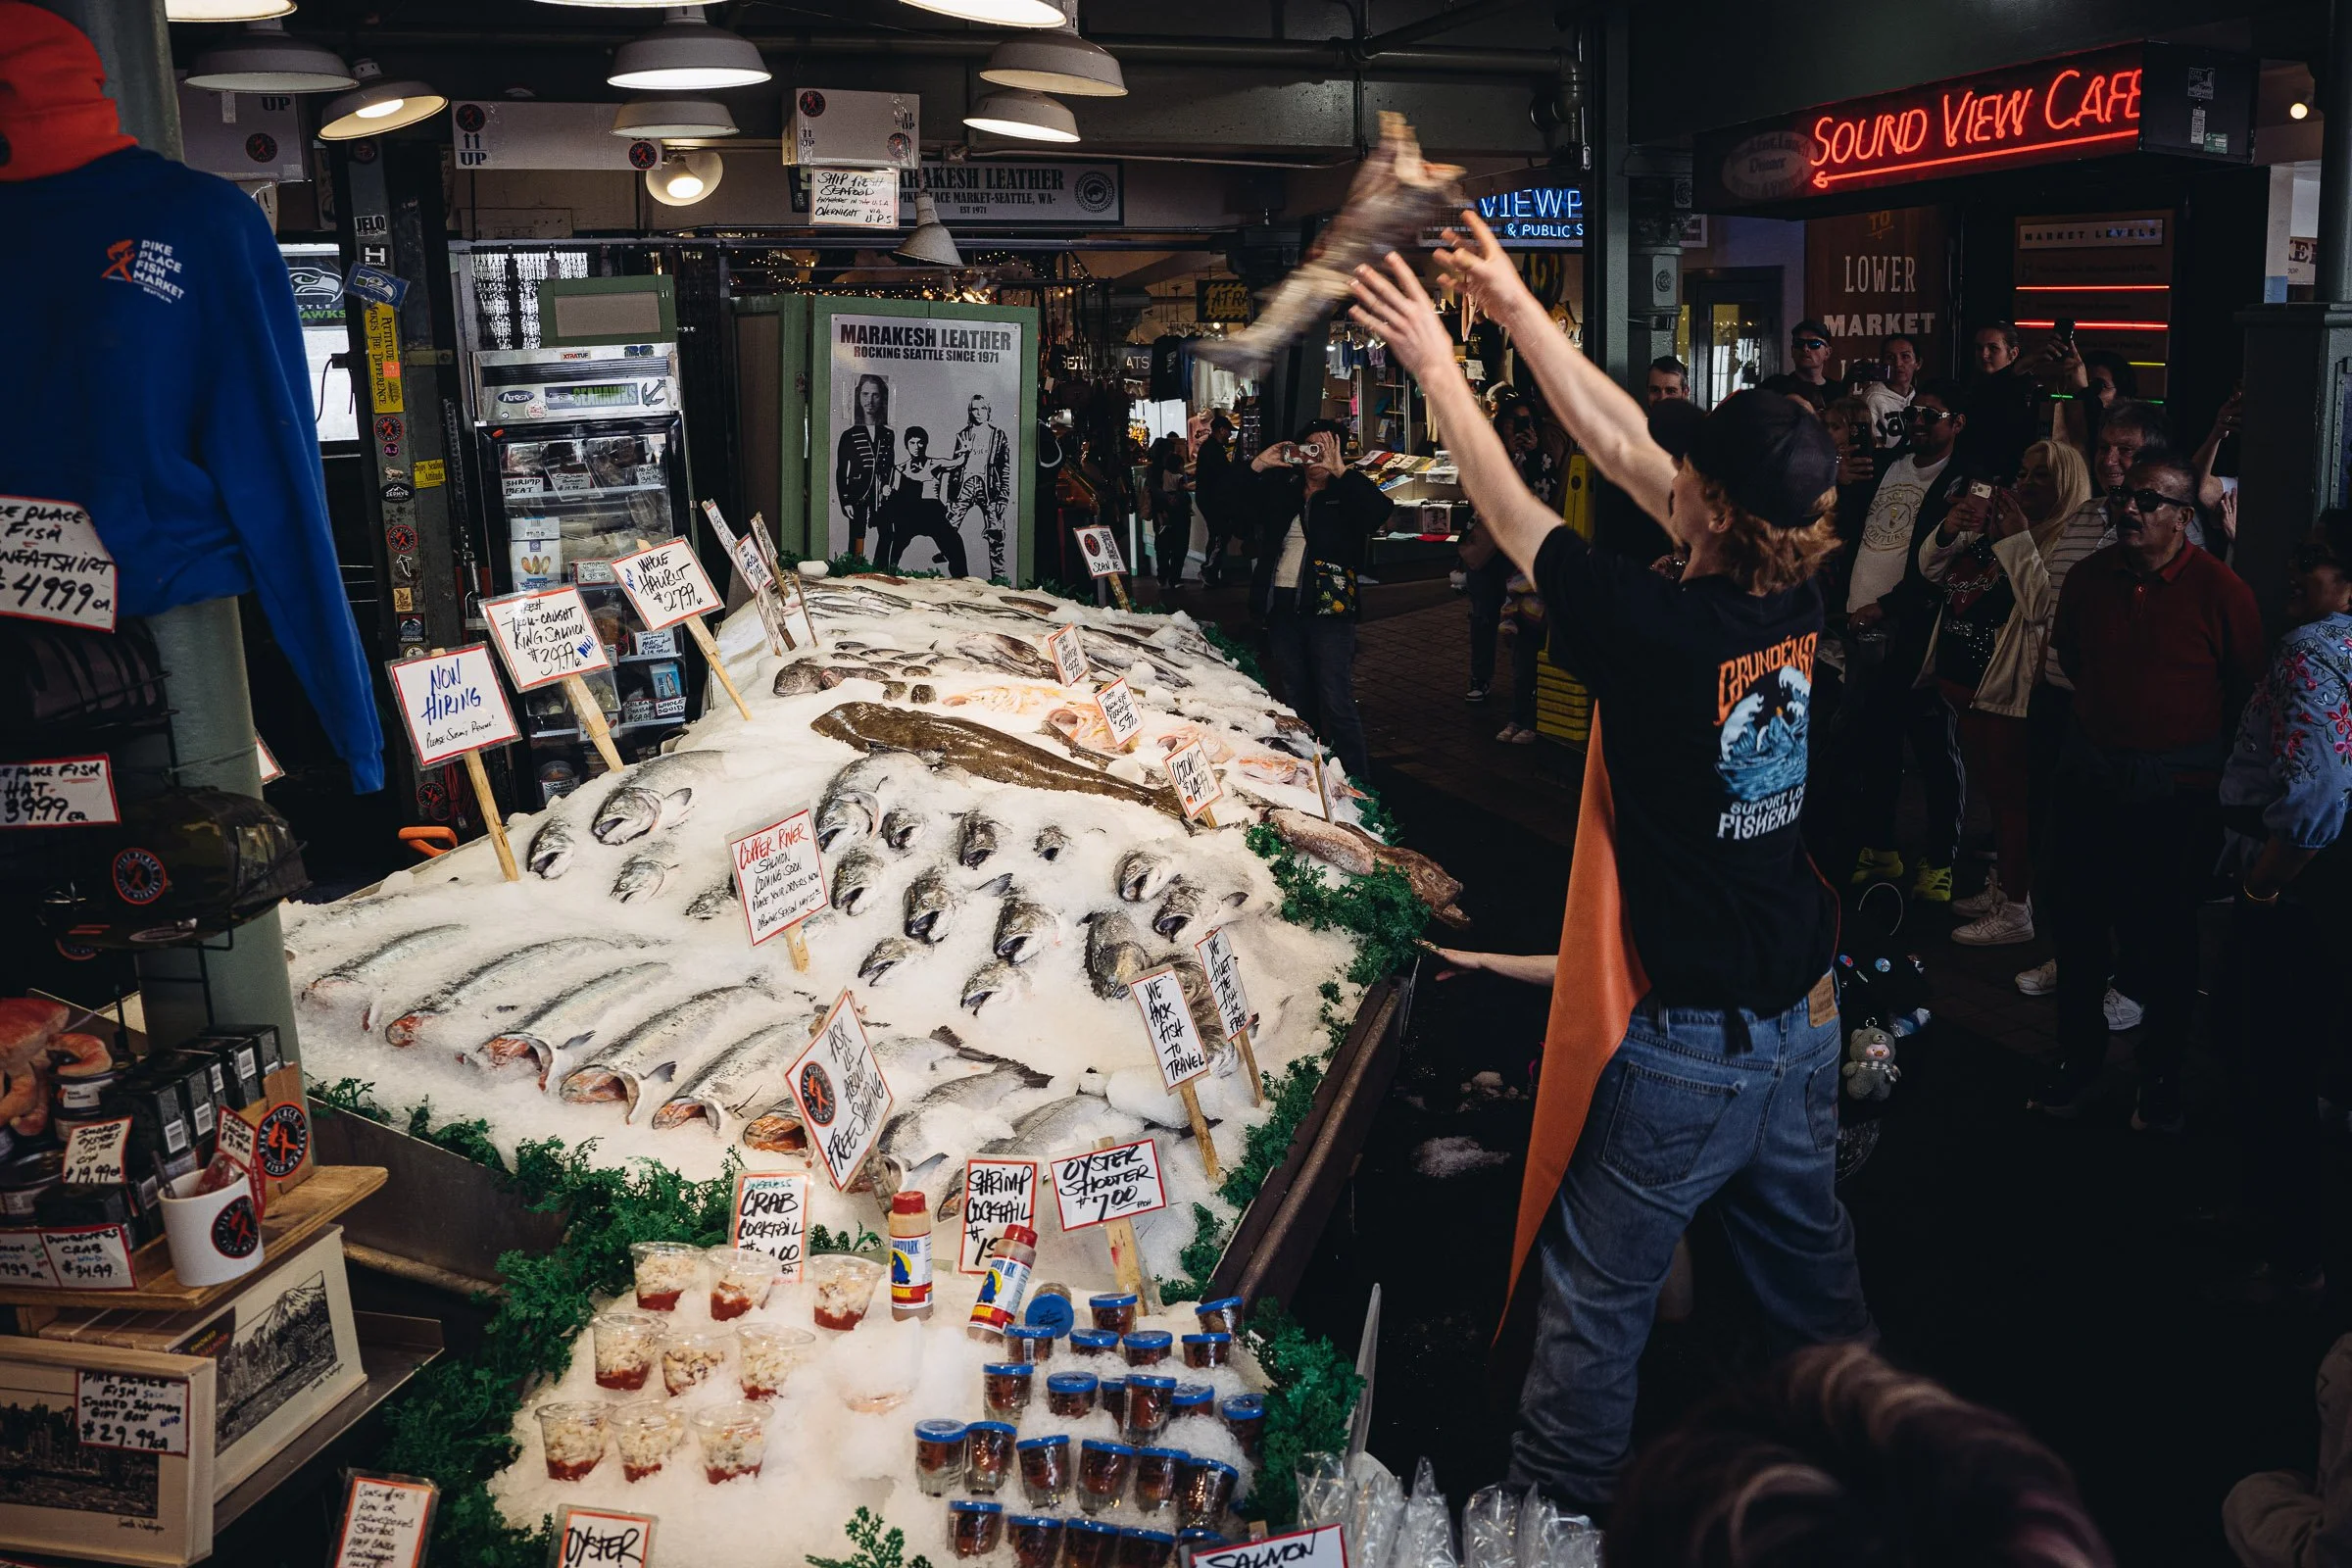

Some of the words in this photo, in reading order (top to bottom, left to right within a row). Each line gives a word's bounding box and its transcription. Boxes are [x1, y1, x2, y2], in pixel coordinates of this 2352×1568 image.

[262, 96, 291, 111] UP
[1811, 108, 1928, 167] SOUND
[1944, 88, 2034, 147] VIEW
[461, 152, 487, 166] UP
[817, 172, 849, 186] SHIP
[899, 168, 979, 190] ARAKESH
[984, 169, 1064, 191] LEATHER
[820, 187, 875, 197] SEAFOOD
[814, 205, 859, 219] OVERNIGHT
[959, 206, 971, 215] EST
[972, 206, 988, 215] 1971
[1507, 223, 1517, 237] &
[1522, 223, 1570, 237] PUBLIC
[2025, 231, 2084, 241] MARKET
[2095, 228, 2156, 238] LEVELS
[141, 239, 173, 257] PIKE
[135, 260, 166, 278] FISH
[138, 250, 183, 273] PLACE
[132, 270, 185, 300] MARKET
[1844, 256, 1916, 293] LOWER
[840, 323, 937, 348] MARAKESH
[941, 328, 1011, 351] LEATHER
[1824, 313, 1936, 337] MARKET
[370, 334, 382, 350] THE
[854, 346, 901, 360] ROCKING
[903, 348, 944, 362] SEATTLE
[946, 349, 976, 363] SINCE
[977, 352, 1000, 364] 1971
[372, 353, 387, 406] DIFFERENCE
[572, 386, 636, 407] SEAHAWKS
[506, 478, 541, 487] SHRIMP
[24, 506, 83, 523] PLACE
[5, 521, 62, 543] FISH
[637, 551, 671, 574] WHOLE
[1093, 561, 1110, 573] SCAN
[638, 563, 691, 596] HALIBUT
[514, 627, 543, 651] KING
[544, 613, 586, 643] SALMON
[431, 658, 462, 696] NOW
[420, 687, 482, 725] HIRING
[658, 699, 683, 709] WHOLE
[658, 705, 683, 713] SQUID
[426, 731, 446, 750] PLEASE
[17, 766, 53, 776] PLACE
[58, 762, 101, 776] FISH
[1731, 795, 1786, 816] SUPPORT
[740, 836, 776, 870] COPPER
[778, 823, 809, 850] RIVER
[755, 848, 791, 874] SALMON
[756, 868, 782, 896] COMING
[753, 895, 769, 913] PLACE
[1208, 934, 1220, 958] WE
[1145, 978, 1164, 1003] WE
[1215, 976, 1232, 995] THE
[1218, 989, 1239, 1012] FISH
[1149, 1001, 1177, 1028] PACK
[1229, 1010, 1248, 1034] FREE
[828, 1017, 853, 1064] ASK
[1159, 1018, 1185, 1044] FISH
[843, 1047, 855, 1073] US
[1164, 1041, 1182, 1058] TO
[844, 1045, 866, 1104] ABOUT
[1165, 1053, 1205, 1081] TRAVEL
[801, 1072, 810, 1100] PIKE
[259, 1123, 271, 1154] PIKE
[271, 1109, 298, 1123] PLACE
[266, 1162, 285, 1173] FISH
[287, 1128, 308, 1170] MARKET
[827, 1119, 858, 1178] FREE
[1062, 1145, 1144, 1182] OYSTER
[967, 1165, 1034, 1197] SHRIMP
[1059, 1164, 1155, 1198] SHOOTER
[740, 1189, 799, 1217] CRAB
[965, 1197, 1034, 1225] COCKTAIL
[737, 1217, 806, 1241] COCKTAIL
[62, 1244, 103, 1254] CRAB
[102, 1385, 137, 1397] FISH
[81, 1396, 128, 1409] SMOKED
[133, 1399, 180, 1415] SALMON
[90, 1407, 118, 1420] GIFT
[123, 1410, 149, 1422] BOX
[565, 1526, 643, 1568] OYSTER
[1206, 1529, 1318, 1568] SALMON
